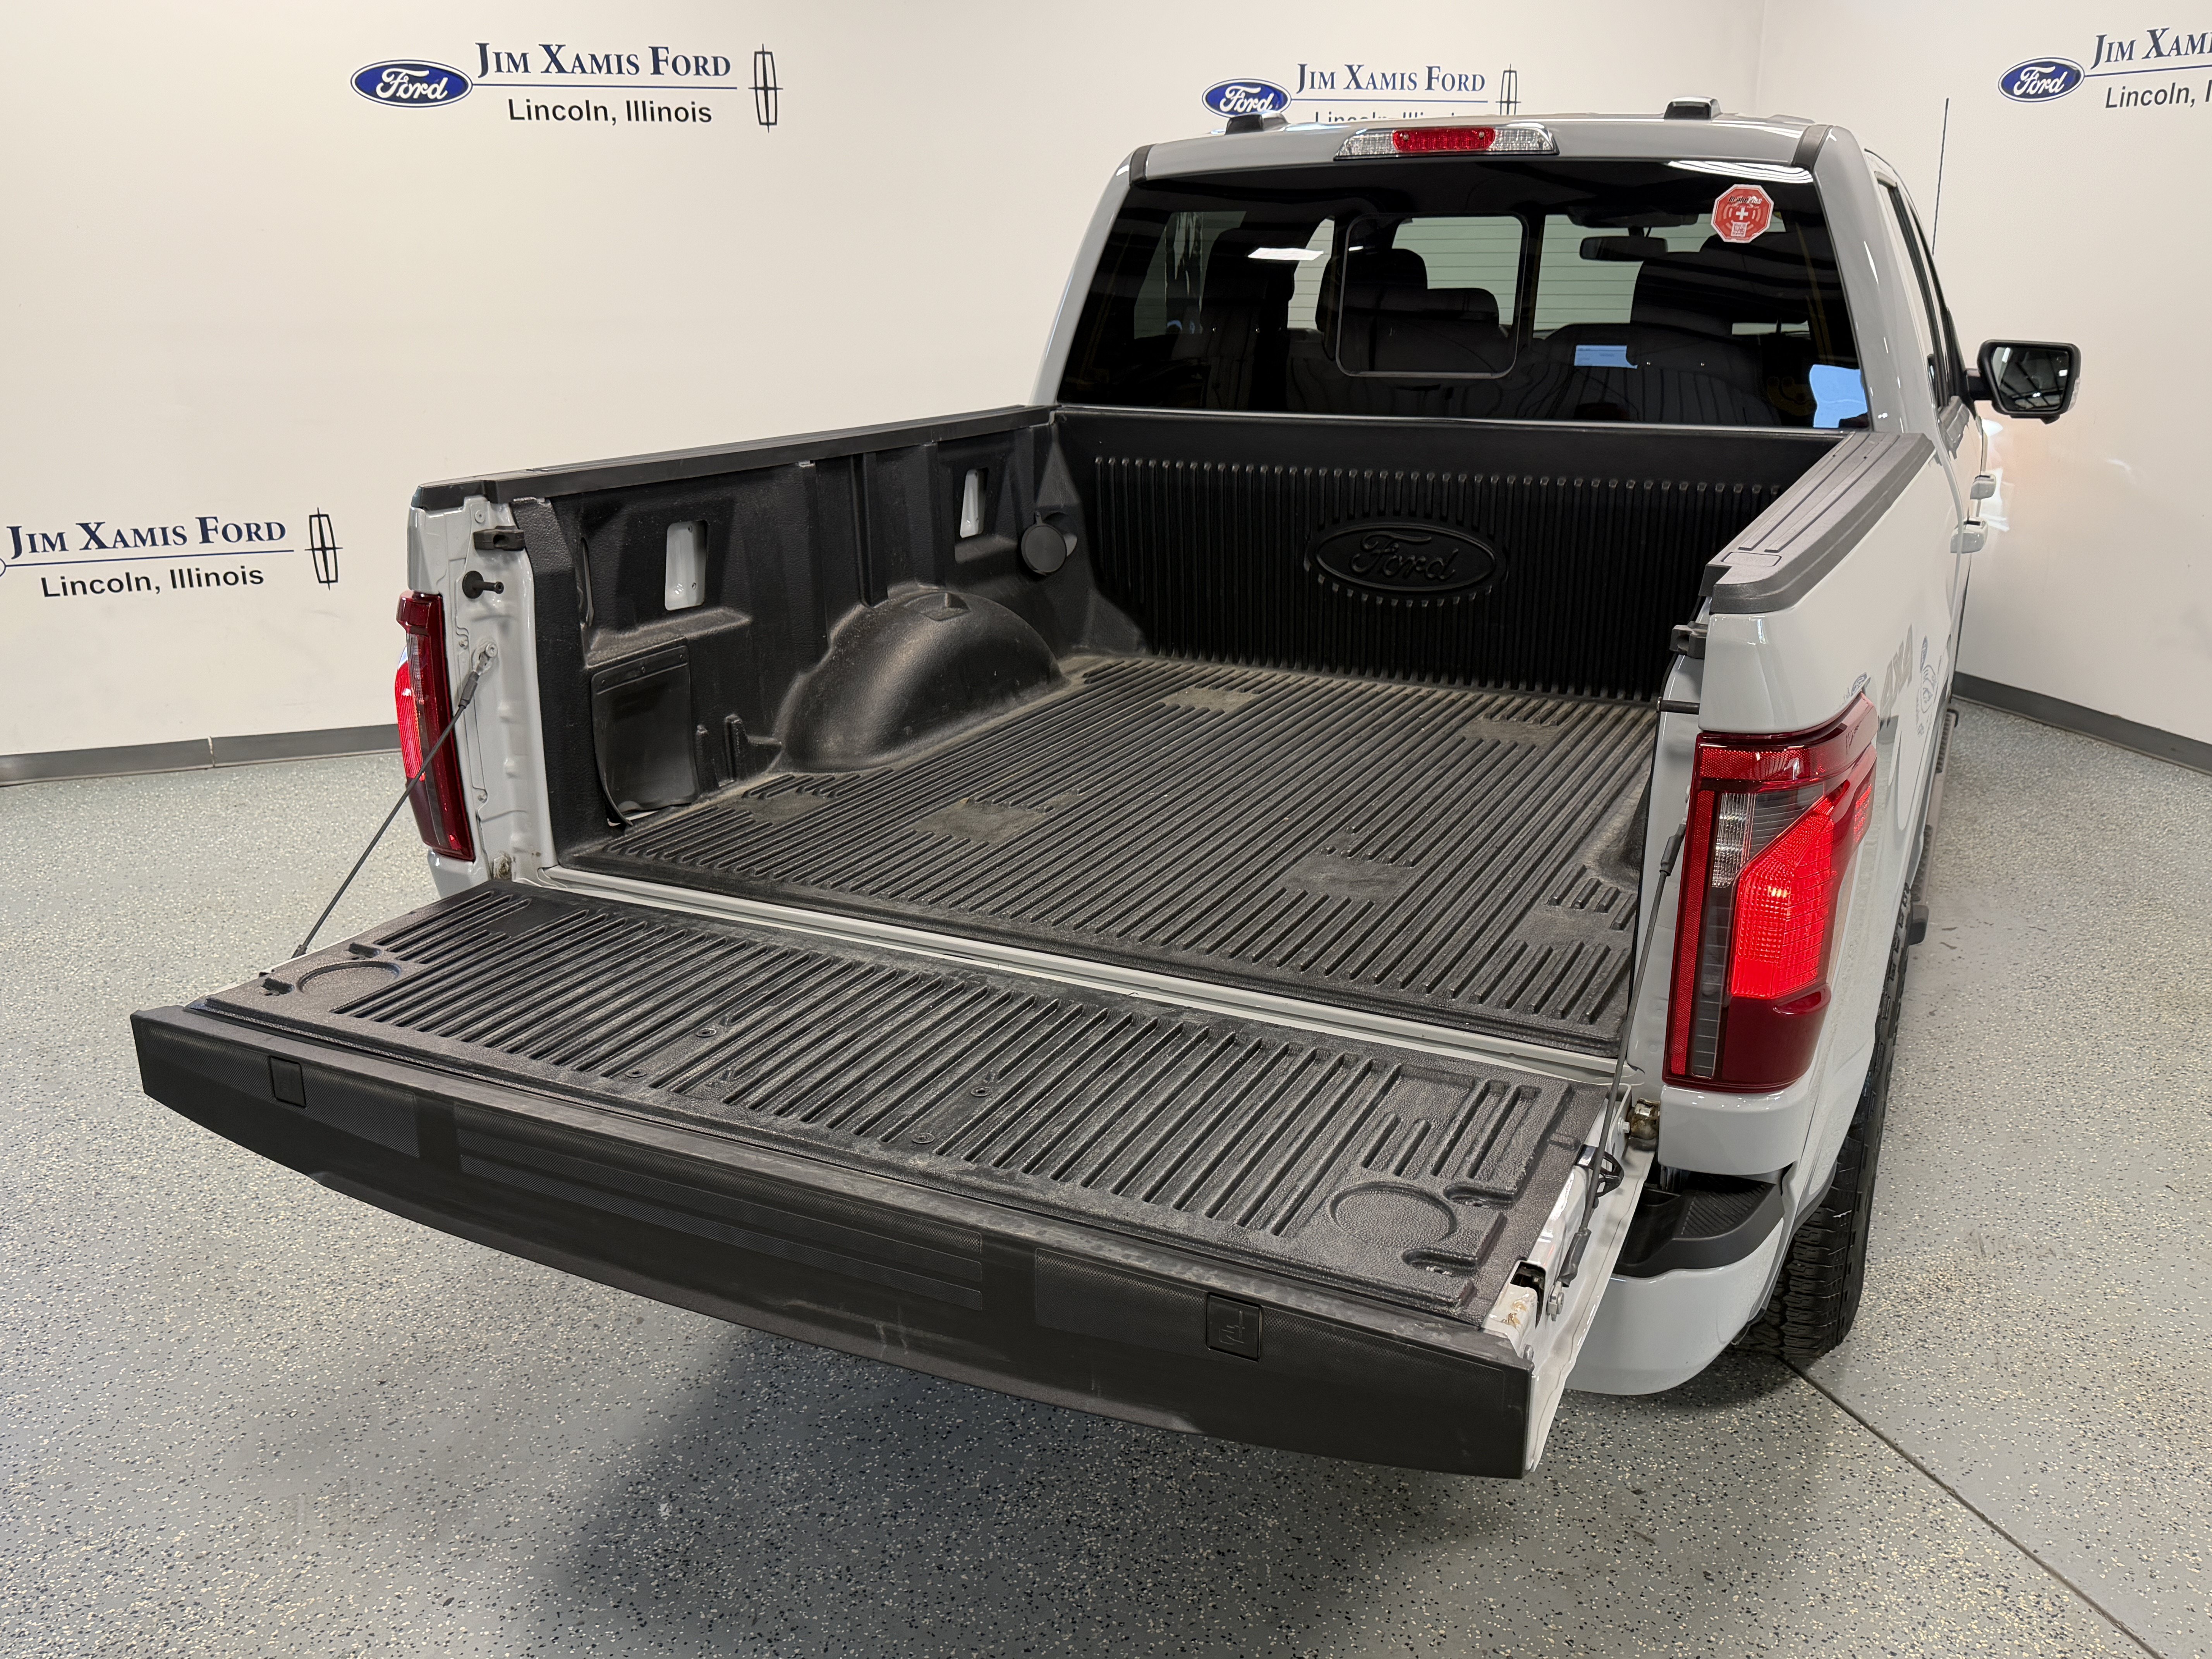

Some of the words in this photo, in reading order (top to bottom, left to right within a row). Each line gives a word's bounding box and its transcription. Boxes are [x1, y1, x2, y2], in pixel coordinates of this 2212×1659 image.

[475, 43, 531, 78] JIM
[538, 43, 640, 75] XAMIS
[648, 46, 731, 77] FORD
[2090, 34, 2136, 70] JIM
[376, 68, 448, 100] Ford
[1296, 64, 1335, 94] JIM
[1343, 64, 1417, 91] XAMIS
[1425, 66, 1485, 92] FORD
[2013, 66, 2068, 96] Ford
[2105, 82, 2195, 108] Lincoln,
[508, 99, 616, 126] Lincoln,
[626, 100, 712, 123] Illinois
[1219, 85, 1274, 112] Ford
[6, 525, 69, 560] JIM
[75, 521, 187, 551] XAMIS
[195, 516, 286, 544] FORD
[1351, 531, 1458, 580] Ford
[41, 572, 160, 598] Lincoln,
[170, 565, 264, 589] Illinois
